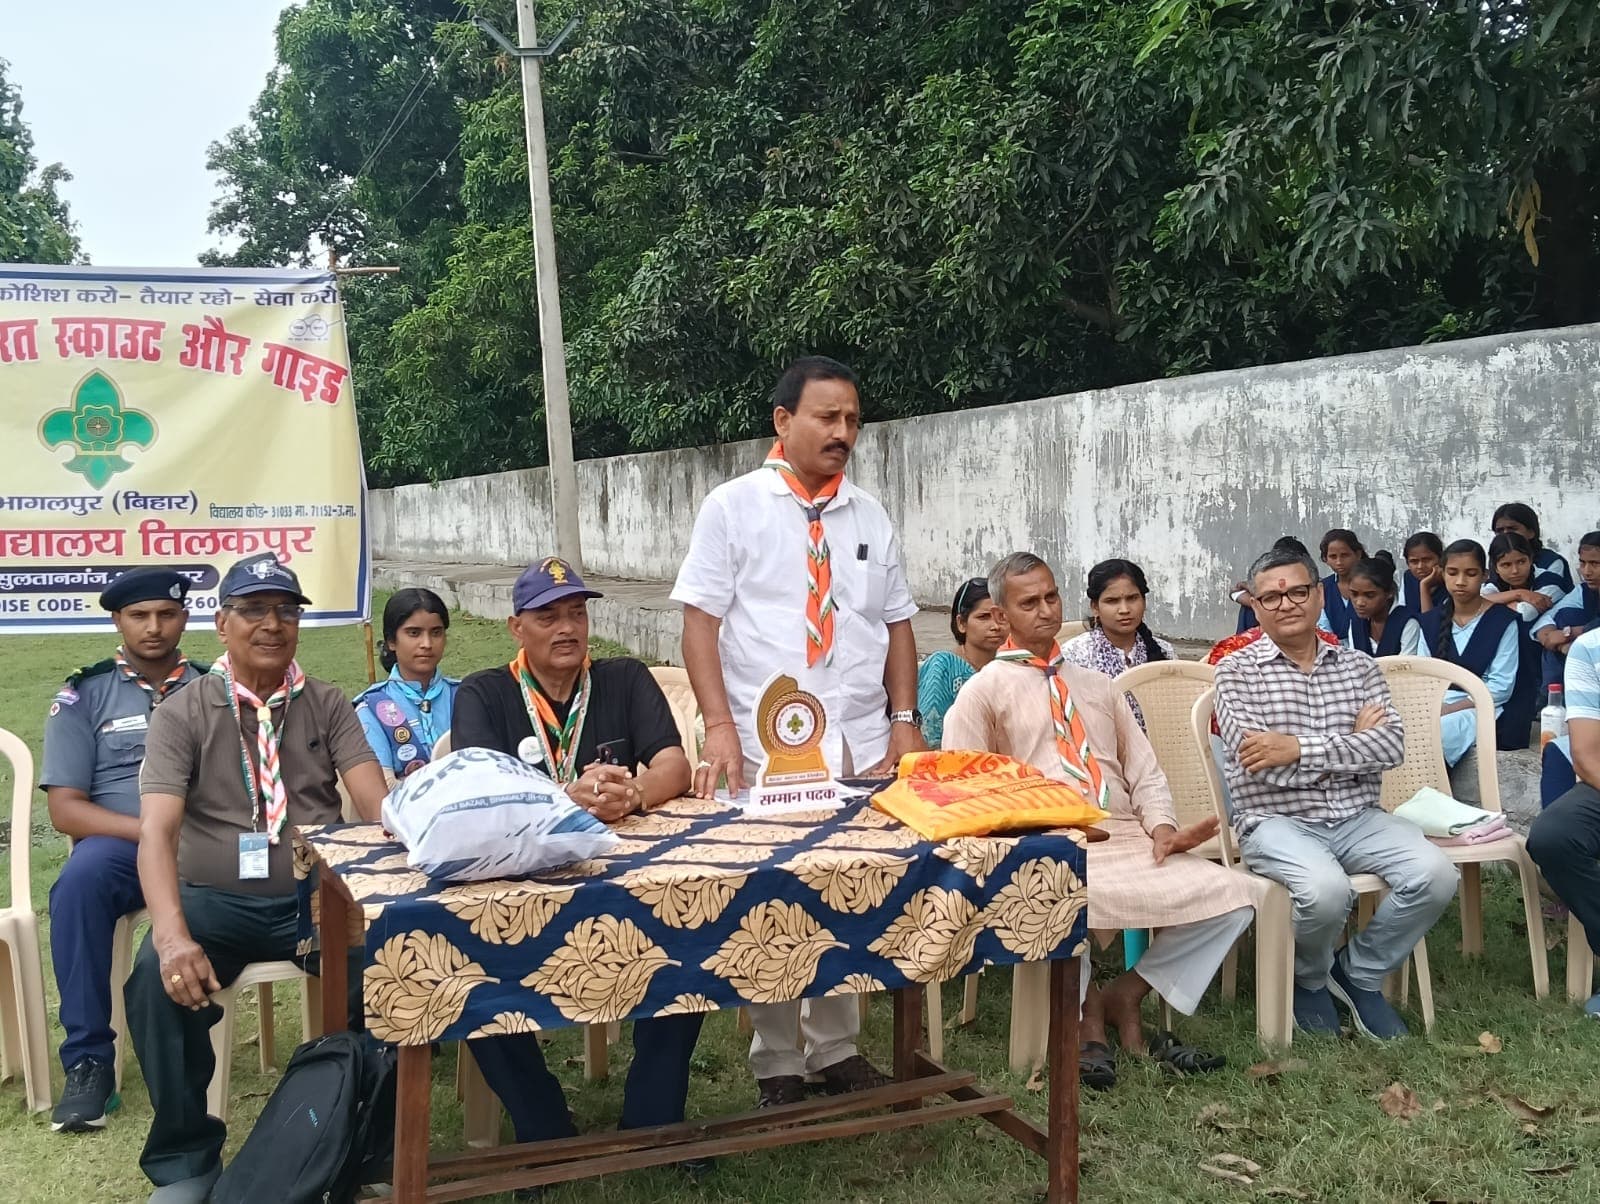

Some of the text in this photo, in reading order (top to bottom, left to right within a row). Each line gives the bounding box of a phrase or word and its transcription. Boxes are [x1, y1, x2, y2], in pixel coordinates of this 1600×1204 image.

[140, 286, 192, 304] तैयार
[254, 288, 295, 306] सेवा
[300, 285, 338, 304] करो
[51, 316, 166, 362] स्काउट
[180, 315, 251, 375] और
[261, 342, 348, 404] गाइड
[112, 490, 198, 515] (बिहार)
[209, 503, 243, 519] विद्यालय
[271, 505, 292, 518] 31033
[0, 519, 315, 564] द्यालय तिलकपुर
[0, 599, 30, 612] ISE
[37, 598, 91, 612] CODE-
[760, 788, 837, 806] सम्मान पदक
